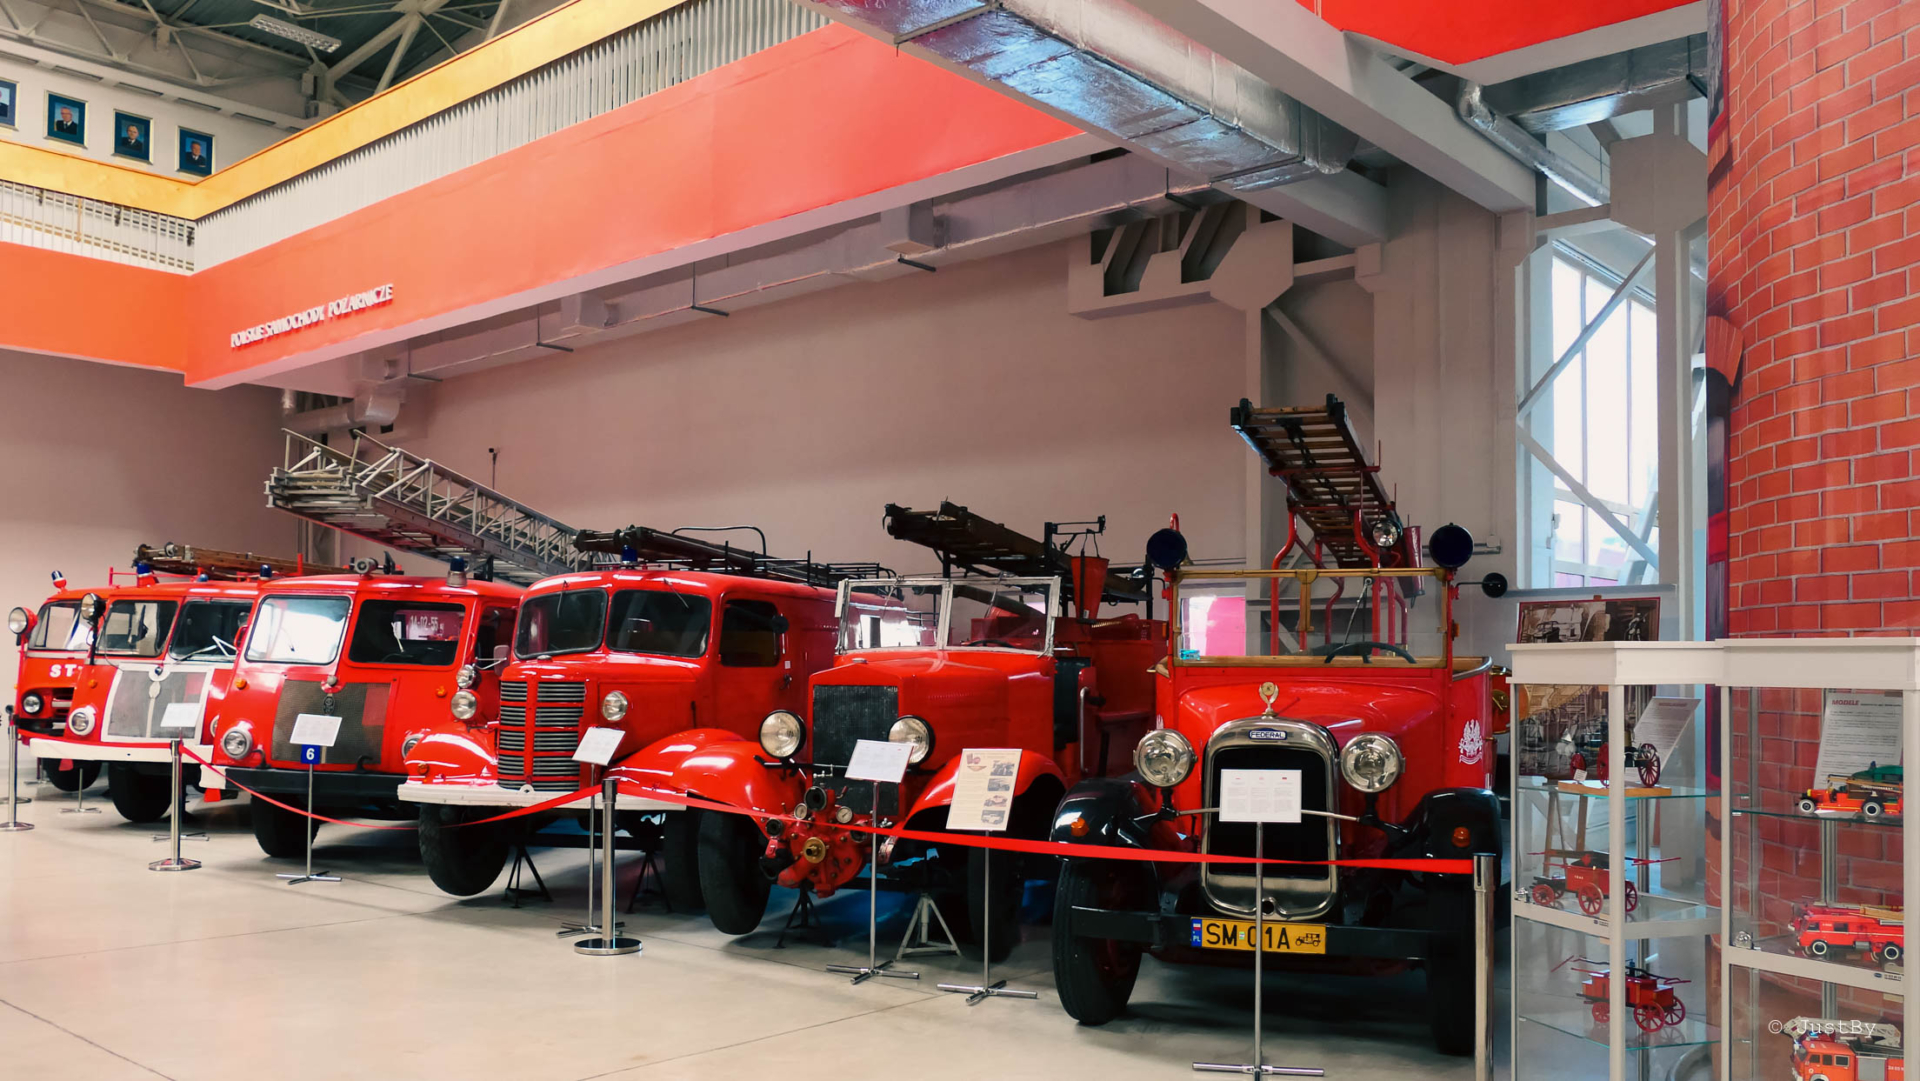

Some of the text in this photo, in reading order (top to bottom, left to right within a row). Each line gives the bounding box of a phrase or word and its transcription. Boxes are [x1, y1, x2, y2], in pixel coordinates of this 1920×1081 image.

[265, 305, 325, 338] SAMOCHODY
[49, 664, 84, 678] ST
[306, 748, 315, 760] 6
[1206, 923, 1238, 947] SM
